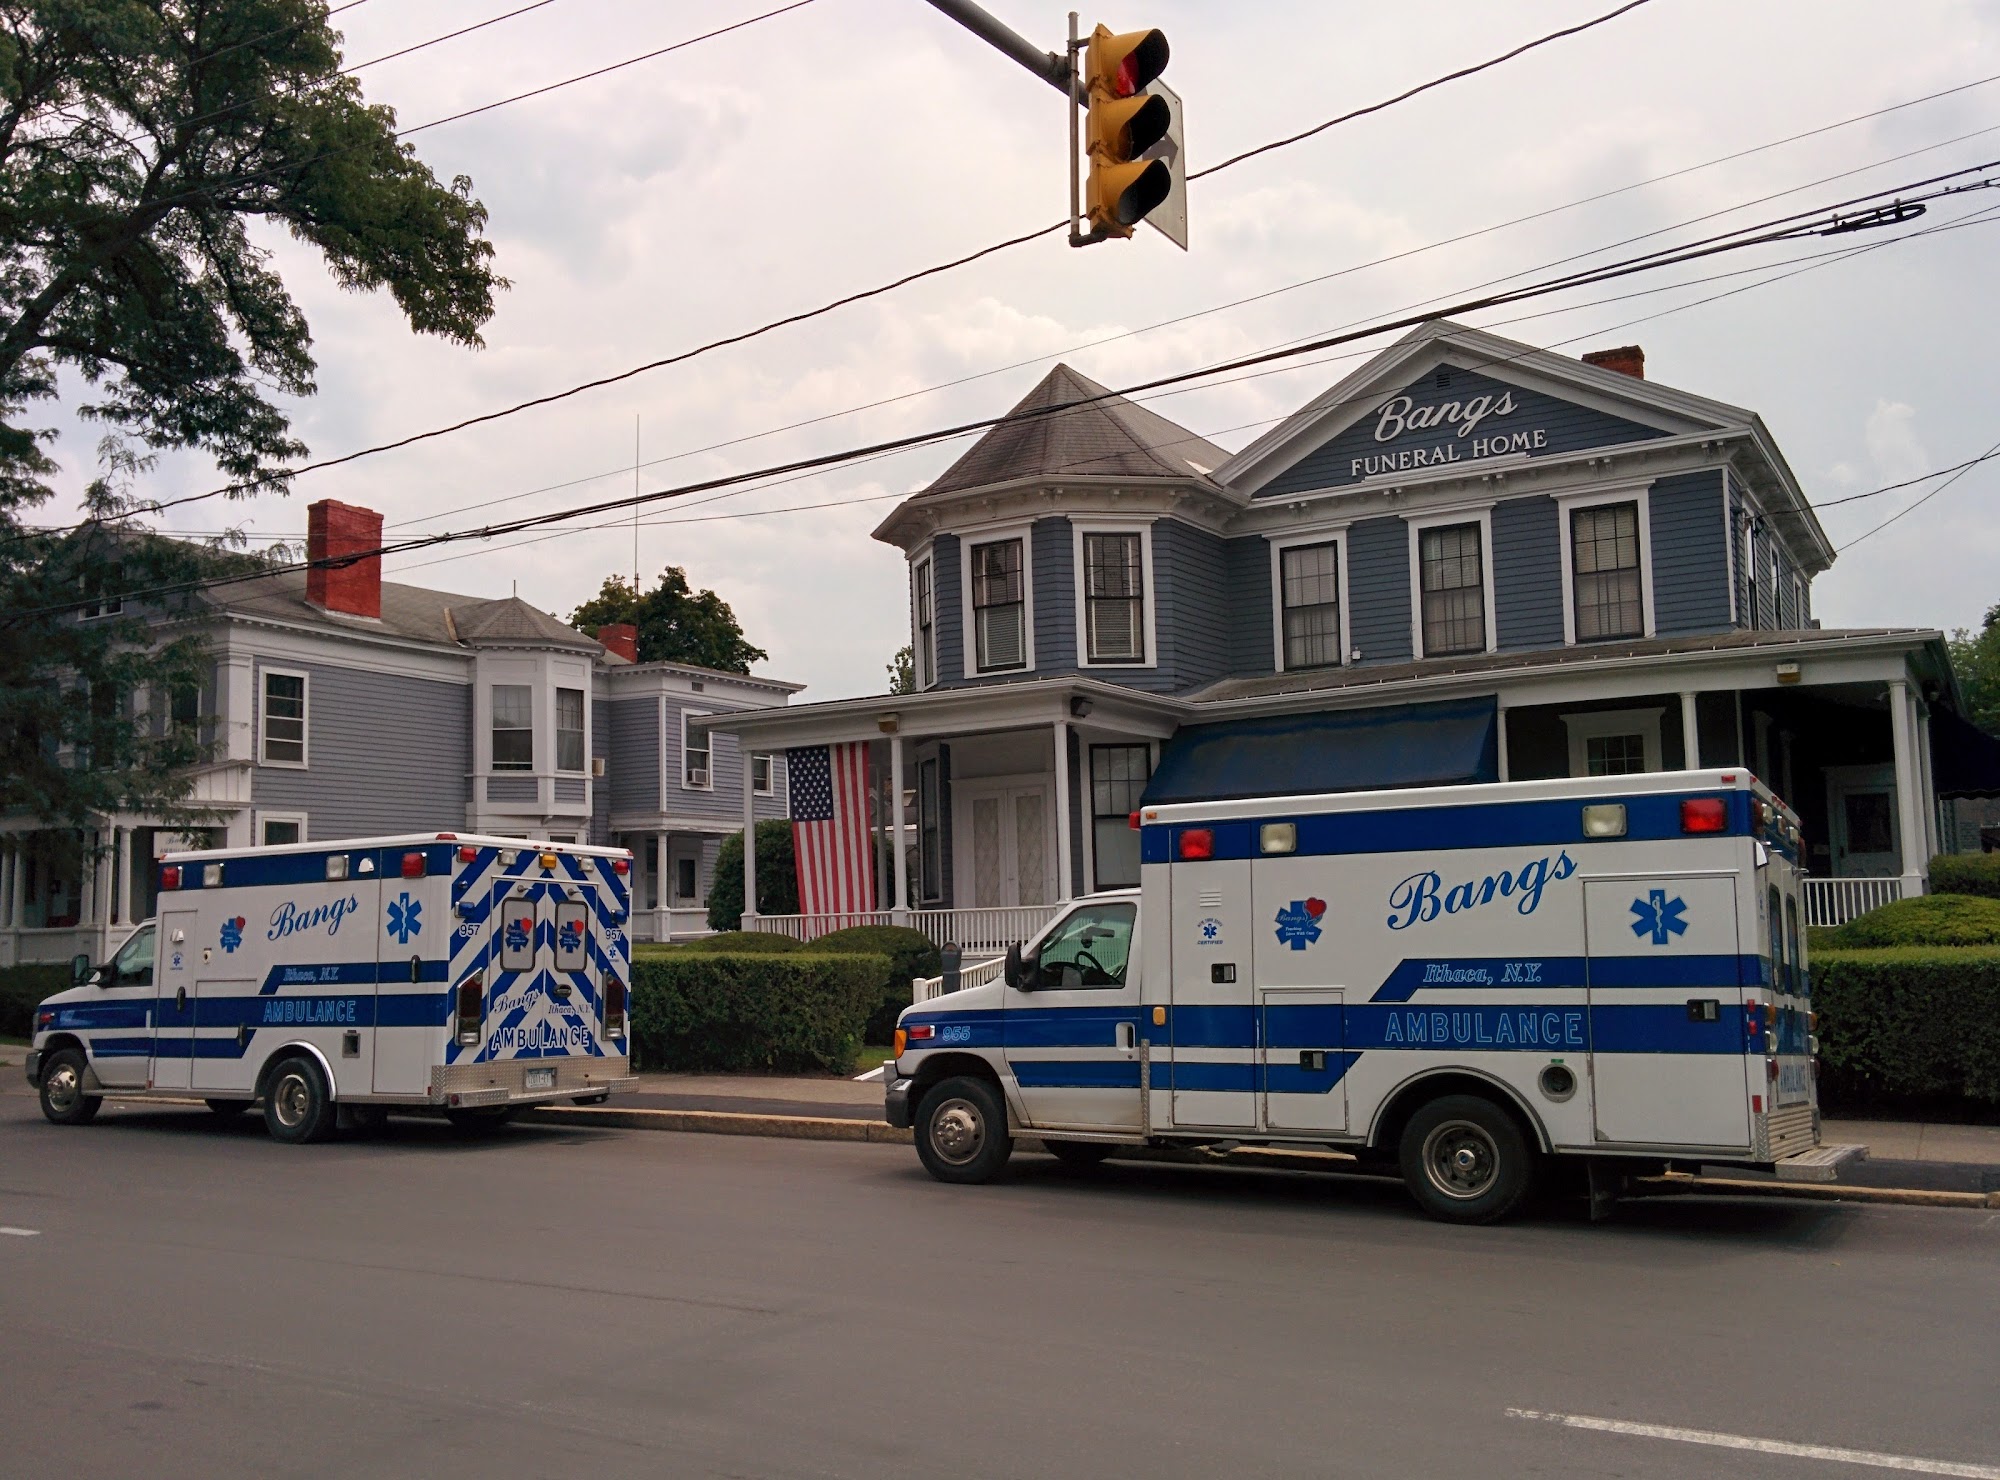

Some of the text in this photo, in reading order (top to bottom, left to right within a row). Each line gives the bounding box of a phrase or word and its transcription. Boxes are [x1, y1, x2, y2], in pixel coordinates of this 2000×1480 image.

[1374, 391, 1518, 442] Bangs
[1351, 429, 1547, 477] FUNERAL HOME
[1387, 850, 1578, 930] Bangs
[267, 893, 358, 941] Bangs
[458, 923, 481, 938] 957
[605, 928, 622, 941] 957
[283, 967, 316, 982] Ithaca,
[1422, 962, 1542, 985] Ithaca, N.Y.
[263, 1000, 356, 1022] AMBULANCE
[494, 988, 539, 1014] Bangs
[548, 1004, 577, 1016] Ithaca,
[491, 1026, 589, 1050] AMBULANCE
[942, 1025, 971, 1041] 955
[1385, 1012, 1583, 1044] AMBULANCE
